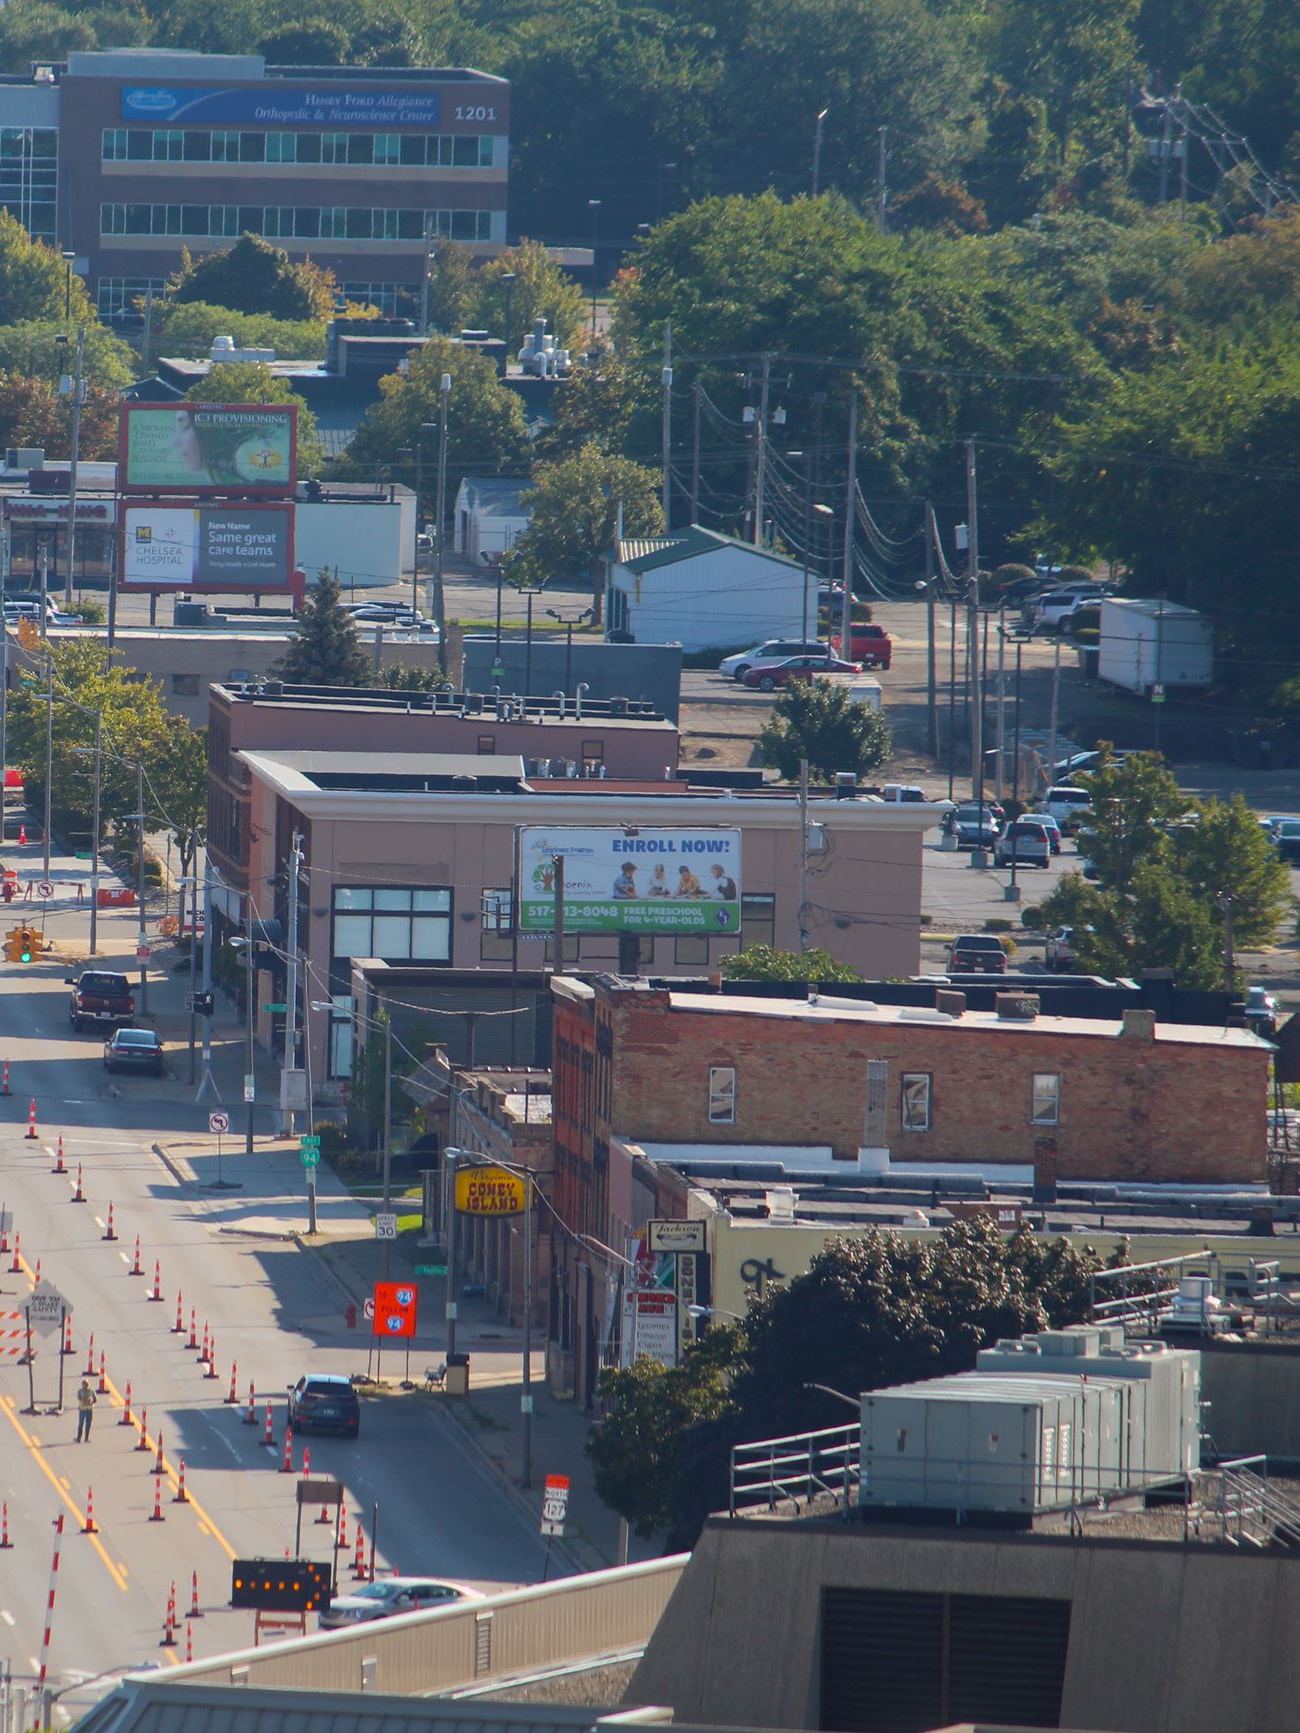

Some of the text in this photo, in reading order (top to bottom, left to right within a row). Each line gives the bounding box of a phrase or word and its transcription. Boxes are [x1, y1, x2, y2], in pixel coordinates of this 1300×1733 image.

[345, 94, 374, 105] FORD
[377, 95, 434, 109] Allegiance
[255, 107, 434, 122] Orthopedic & Neuroscience Center
[455, 107, 496, 120] 1201
[213, 413, 288, 424] PROVISIONING
[208, 521, 251, 530] New Name
[208, 531, 277, 546] Same great
[136, 547, 184, 555] CHELSEA
[208, 545, 274, 556] care teams
[136, 555, 183, 565] HOSPITAL
[612, 839, 731, 853] ENROLL NOW!
[528, 905, 704, 917] 517-13-8048 FREE PRESCHOOL
[623, 916, 705, 925] FOR 4-YEAR-OLDS
[303, 1152, 316, 1162] 94
[469, 1182, 516, 1197] CONEY
[466, 1196, 518, 1211] ISLAND
[379, 1226, 394, 1237] 30
[397, 1291, 411, 1301] 94
[387, 1318, 401, 1329] 94
[638, 1321, 671, 1331] igarettes
[546, 1504, 565, 1516] 127
